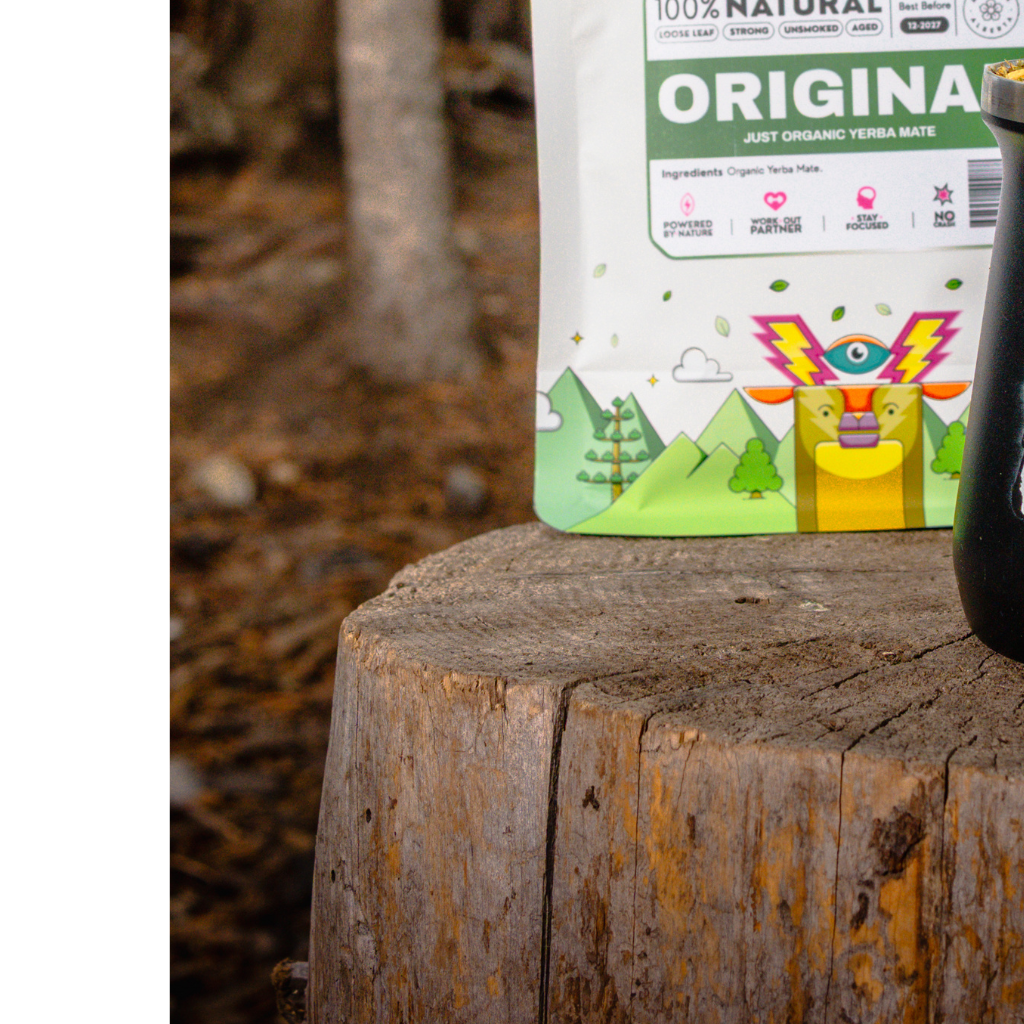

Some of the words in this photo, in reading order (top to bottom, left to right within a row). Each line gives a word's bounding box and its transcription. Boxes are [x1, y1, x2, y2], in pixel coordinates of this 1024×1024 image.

[899, 2, 919, 11] Best
[921, 0, 952, 10] Before
[729, 26, 770, 36] STRONG
[783, 24, 839, 34] UNSMOKED
[851, 22, 879, 32] AGED
[659, 29, 690, 39] LOOSE
[692, 28, 715, 38] LEAF
[658, 64, 982, 124] ORIGINA
[743, 131, 779, 144] JUST
[781, 128, 846, 142] ORGANIC
[848, 127, 897, 140] YERBA
[899, 125, 937, 138] MATE
[661, 168, 723, 180] Ingredients
[727, 166, 765, 178] Organic
[767, 164, 794, 174] Yerba
[796, 163, 823, 174] Mate.
[856, 213, 879, 223] STAY
[934, 210, 956, 223] NO
[663, 219, 713, 230] POWERED
[750, 223, 803, 235] PARTNER
[845, 221, 889, 231] FOCUSED
[678, 228, 713, 238] NATURE
